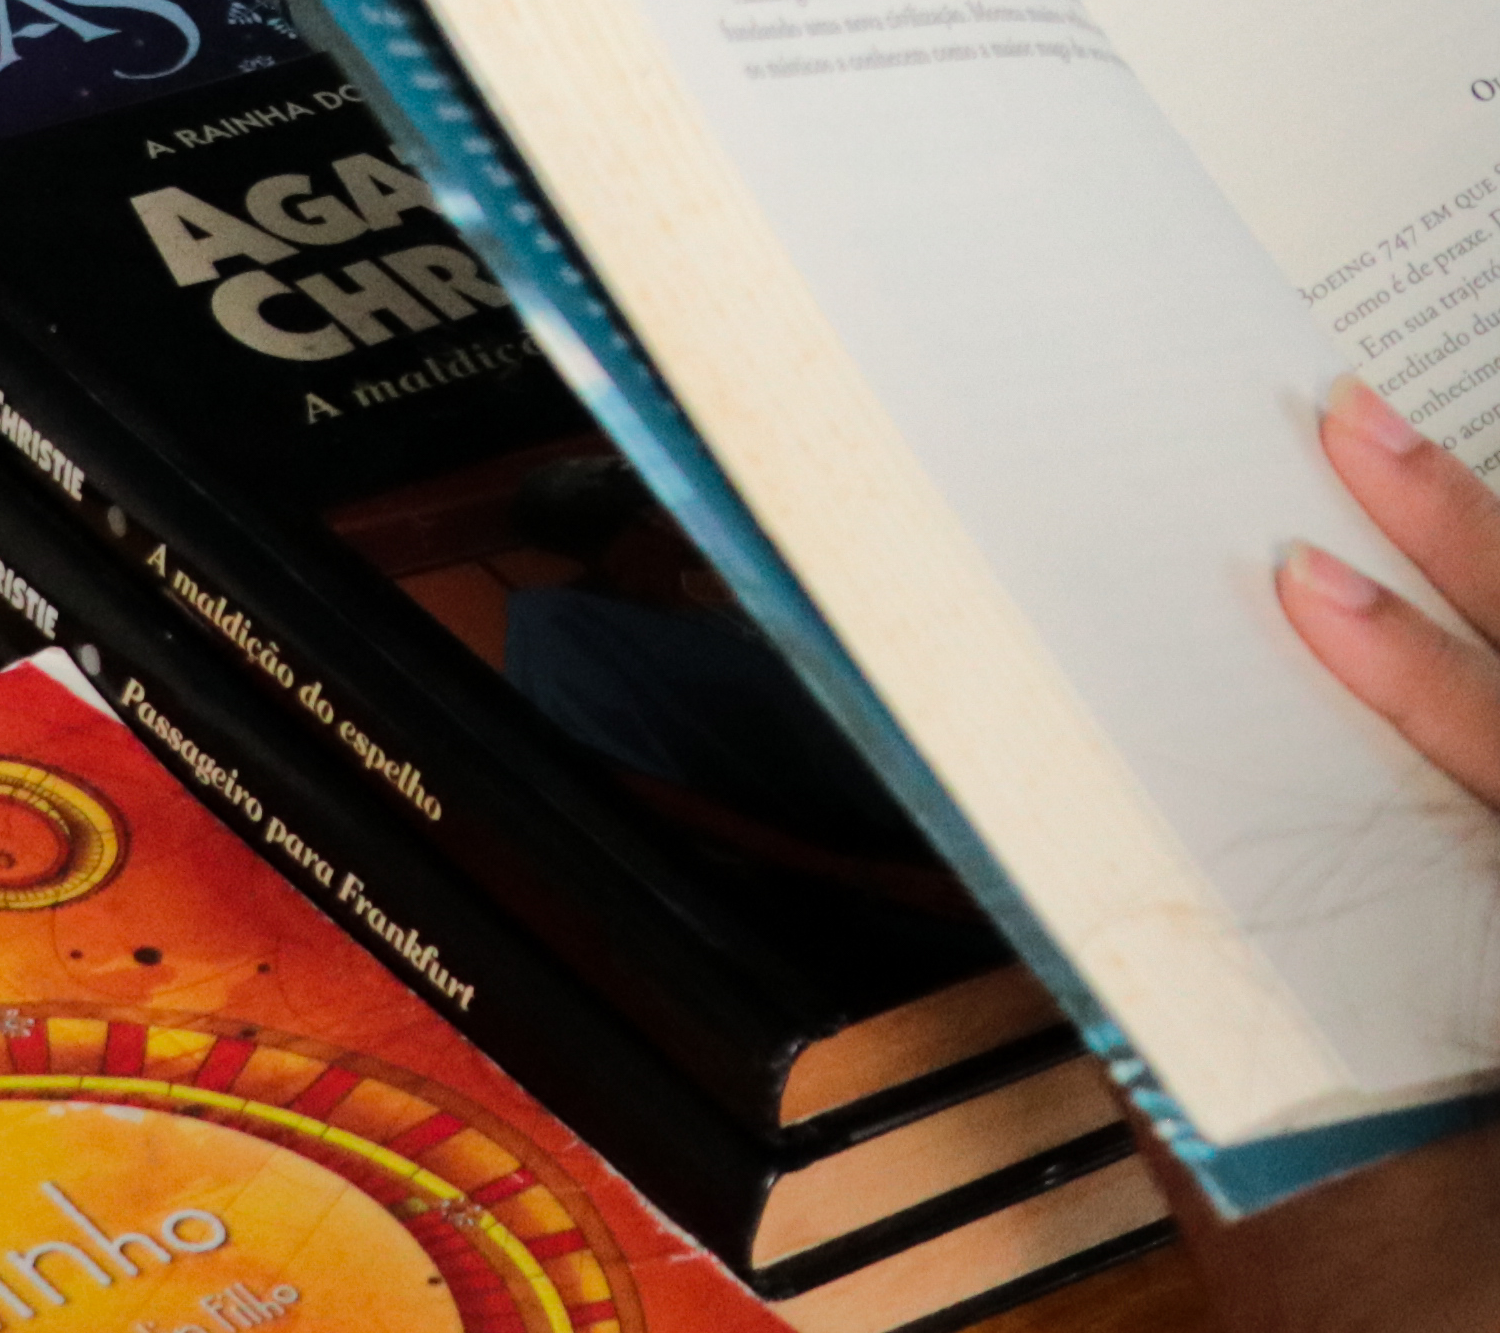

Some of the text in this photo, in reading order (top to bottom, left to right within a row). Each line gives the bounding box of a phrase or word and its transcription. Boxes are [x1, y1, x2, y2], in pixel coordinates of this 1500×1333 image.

[144, 136, 168, 160] A
[176, 99, 316, 151] RAINHA
[1377, 224, 1416, 259] 747
[1454, 178, 1496, 209] QUE
[1333, 290, 1390, 332] como
[1391, 274, 1405, 293] é
[1407, 262, 1432, 284] de
[1432, 229, 1492, 275] praxe.
[1358, 329, 1403, 359] Em
[1403, 306, 1439, 332] sua
[305, 393, 341, 426] A
[147, 543, 444, 823] A maldição do espelho
[120, 676, 476, 1012] Passageiro para Frankfurt
[200, 1282, 301, 1333] Filho
